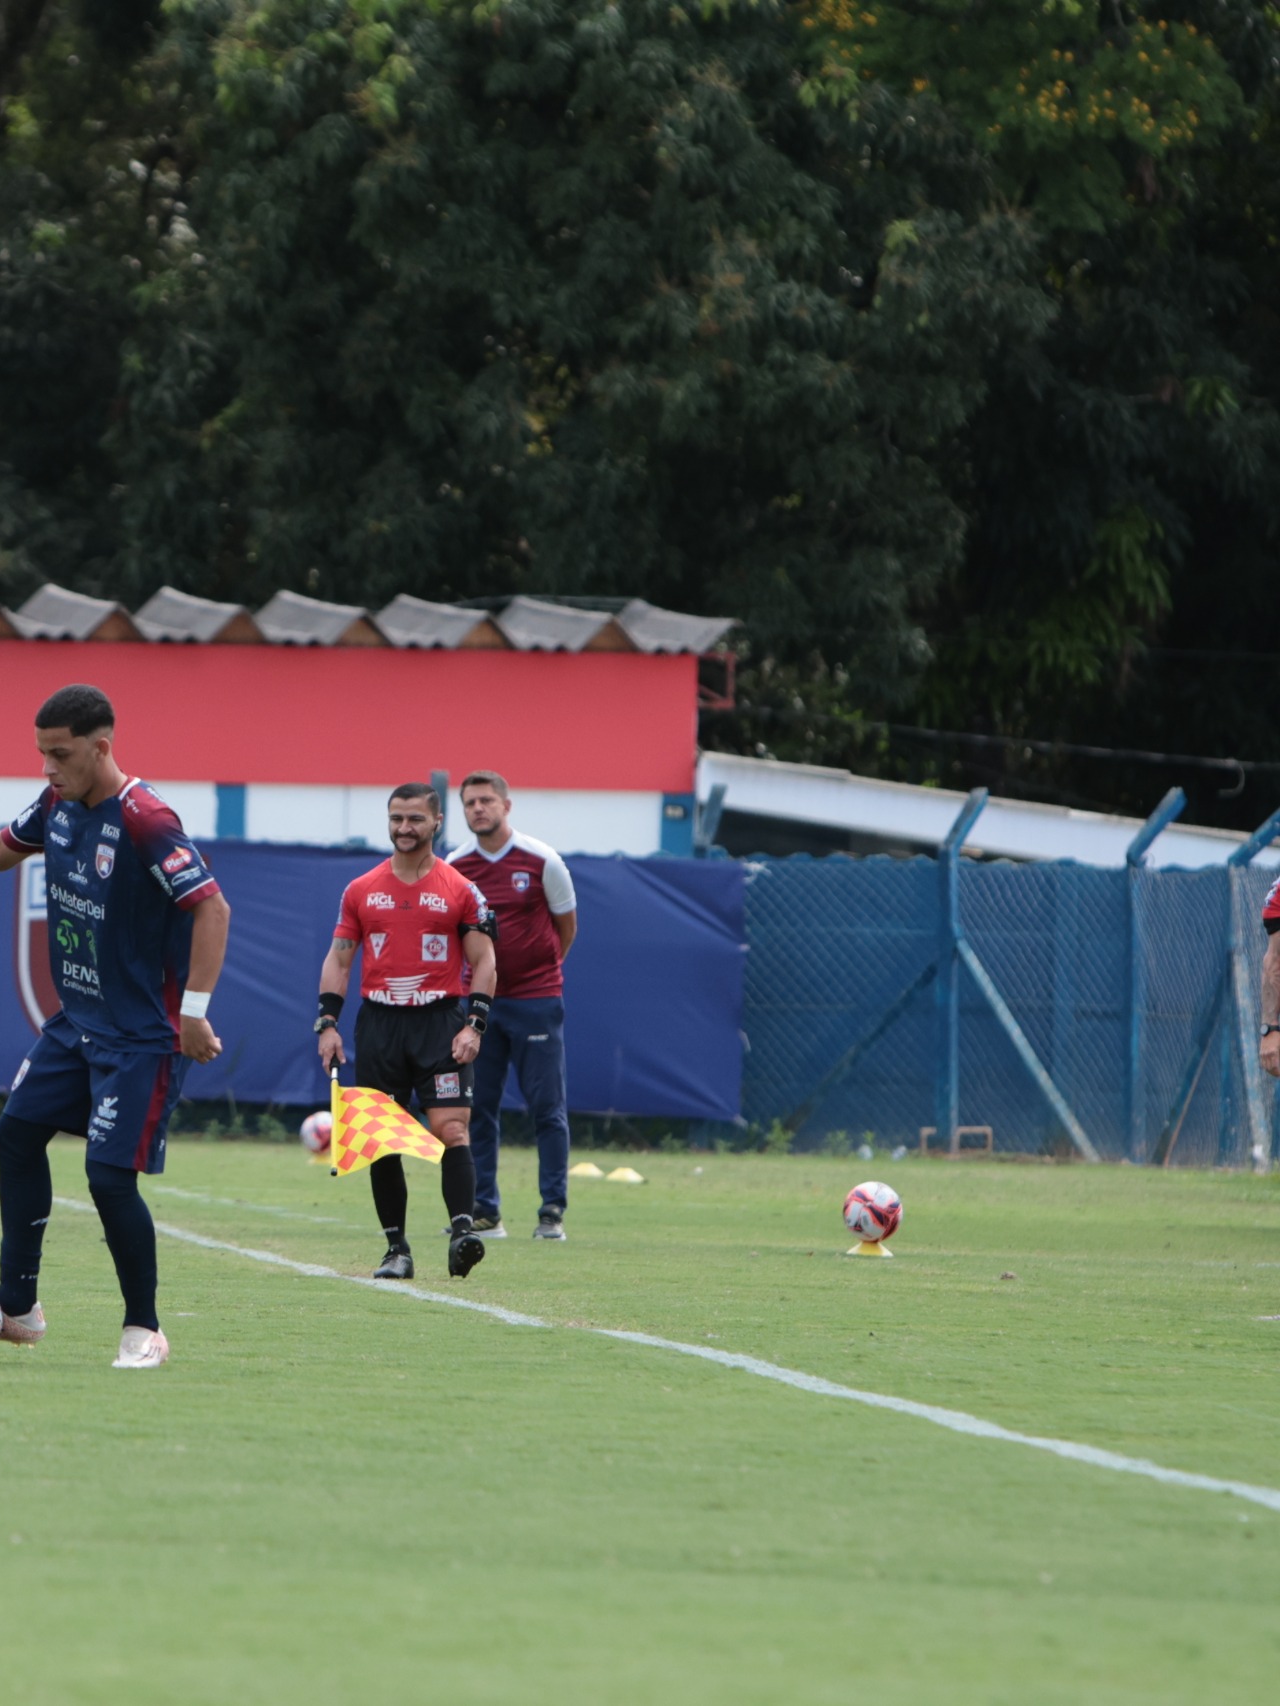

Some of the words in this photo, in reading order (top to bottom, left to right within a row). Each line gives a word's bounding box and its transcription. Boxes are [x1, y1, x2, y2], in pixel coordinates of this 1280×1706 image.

[102, 823, 121, 839] EGIS
[367, 895, 395, 908] MGL
[419, 895, 448, 909] MGL
[63, 960, 99, 985] DENS
[437, 1086, 460, 1095] GIRO
